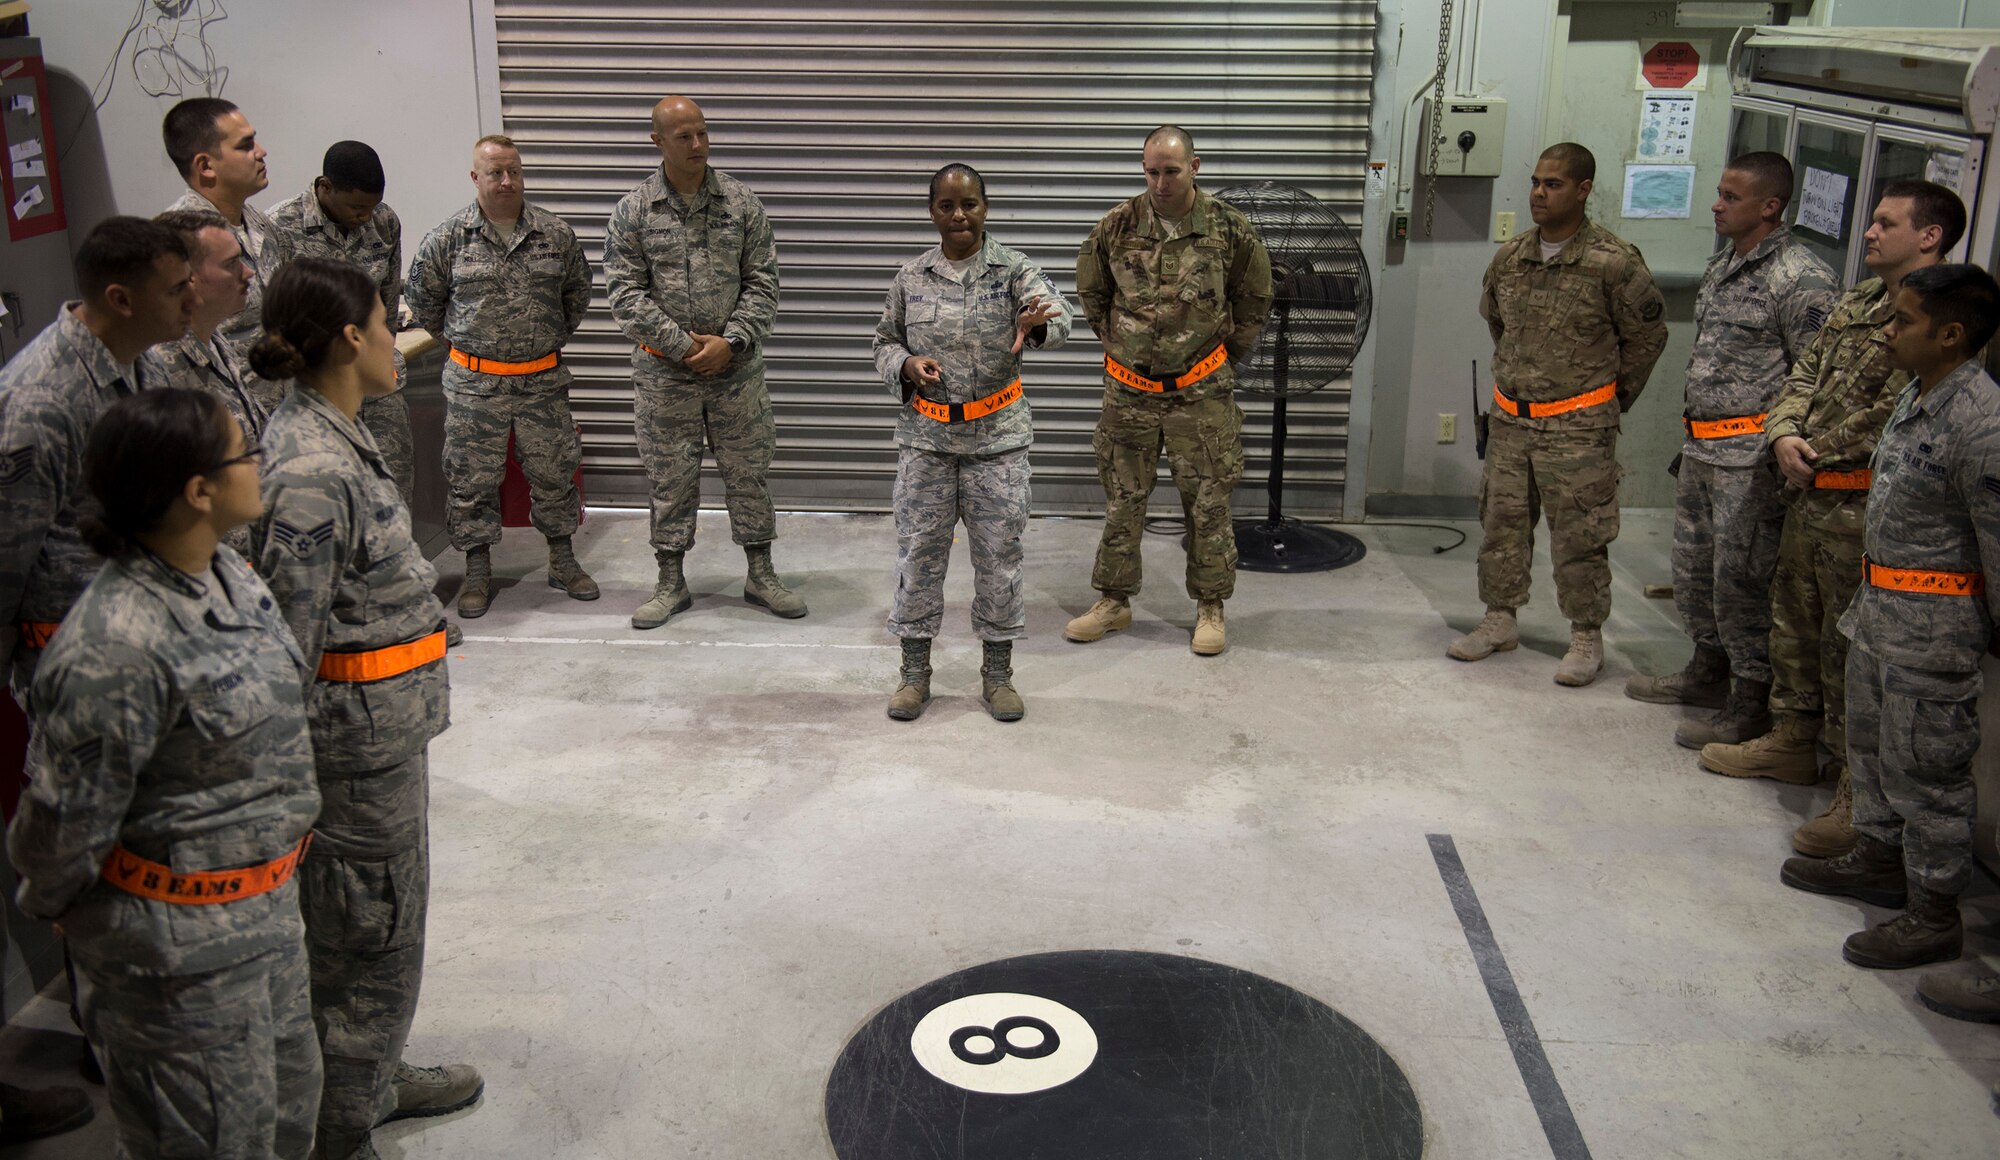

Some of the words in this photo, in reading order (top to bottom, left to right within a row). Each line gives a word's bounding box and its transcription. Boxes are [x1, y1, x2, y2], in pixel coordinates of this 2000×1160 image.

[1657, 48, 1689, 58] STOP!
[1809, 169, 1832, 193] DON'T
[998, 388, 1016, 406] AMC
[1911, 455, 1922, 468] AIR
[1923, 460, 1947, 475] FORCE
[166, 877, 243, 897] EAMS
[949, 1015, 1061, 1065] 8
